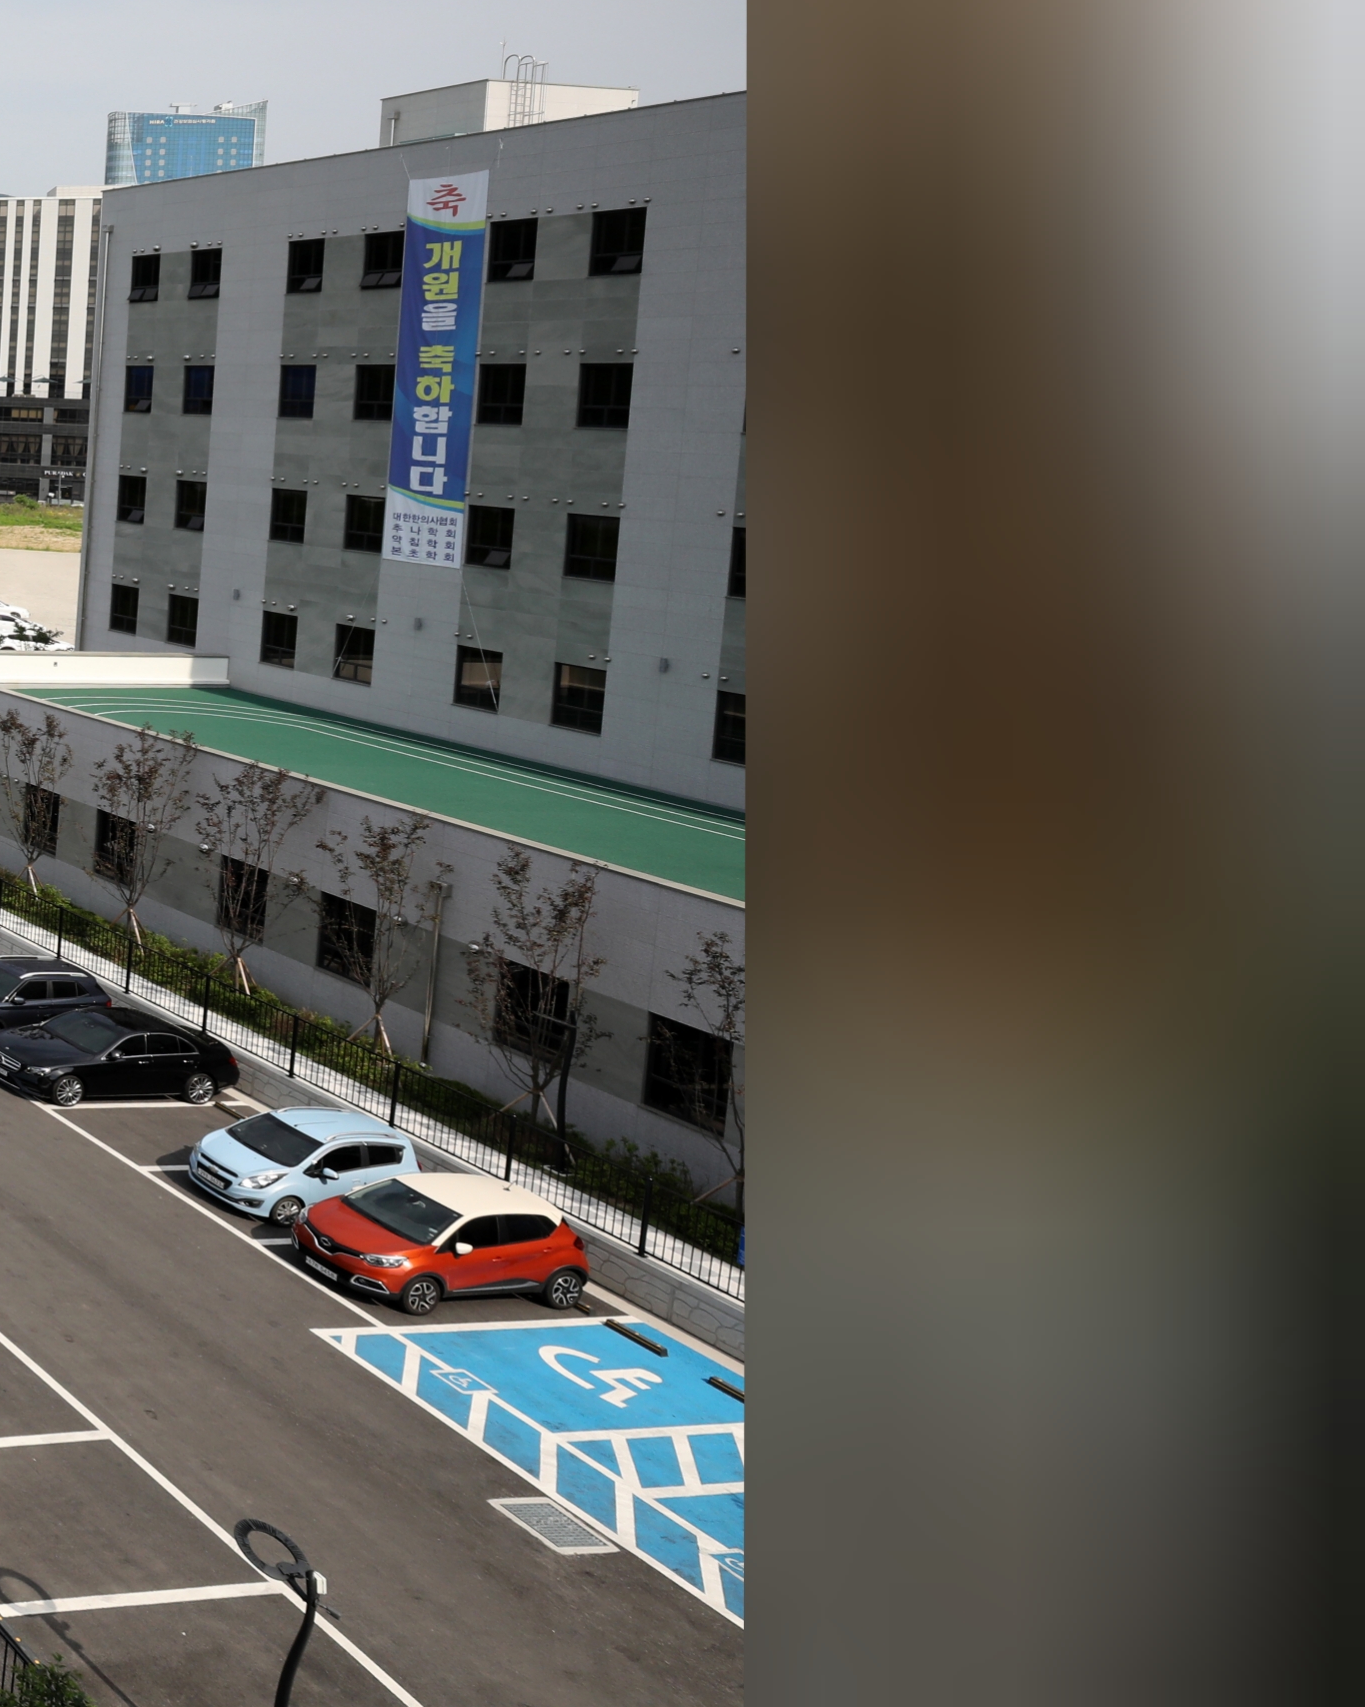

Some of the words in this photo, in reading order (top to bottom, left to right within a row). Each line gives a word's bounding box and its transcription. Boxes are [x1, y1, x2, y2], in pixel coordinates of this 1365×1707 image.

[426, 184, 467, 217] 축
[421, 240, 462, 331] 개원을
[409, 344, 455, 496] 축하합니다
[393, 512, 457, 527] 대한한의사협회
